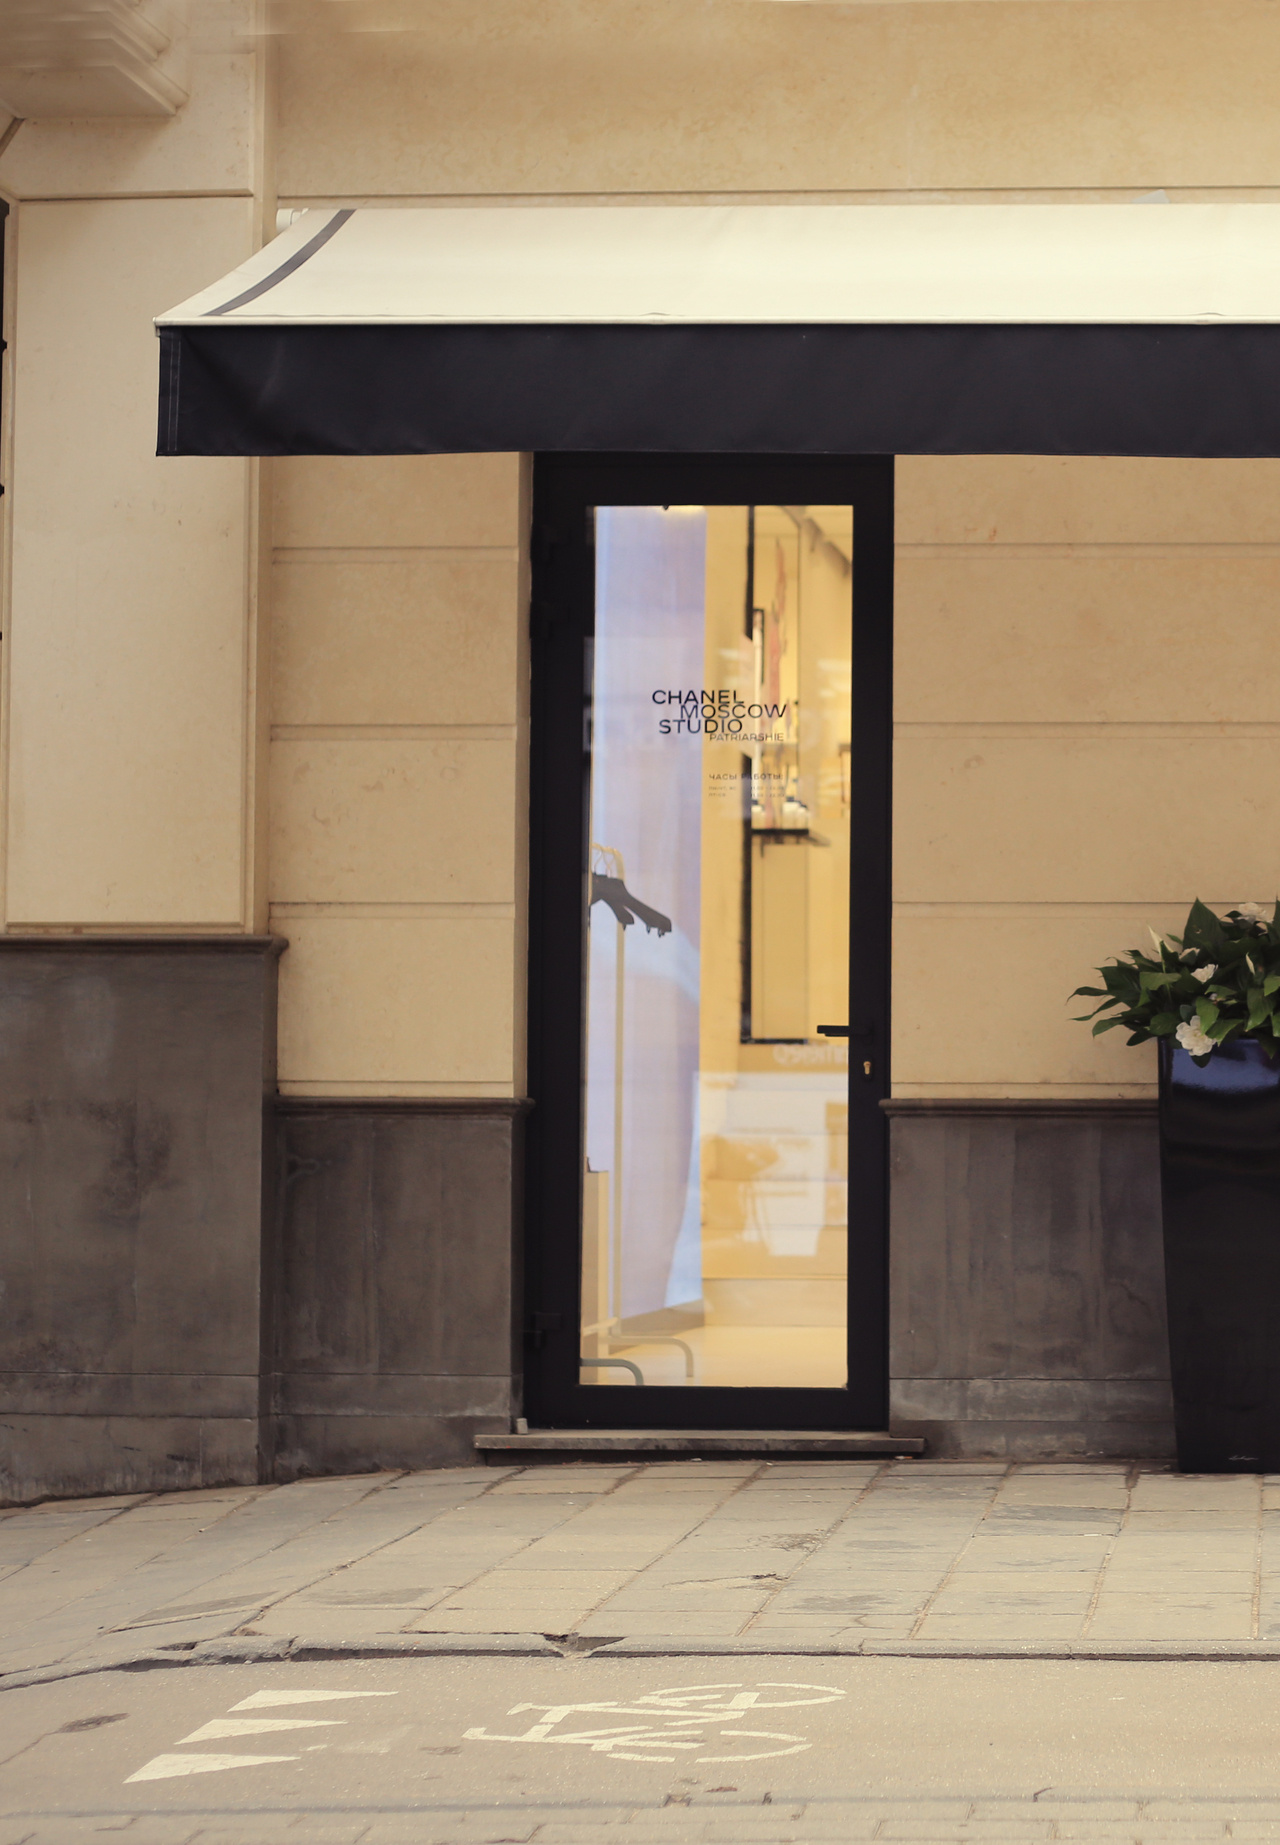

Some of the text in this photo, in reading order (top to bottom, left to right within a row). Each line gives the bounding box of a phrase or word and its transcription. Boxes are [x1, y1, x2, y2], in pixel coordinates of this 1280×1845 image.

[652, 690, 744, 704] CHANEL
[680, 704, 787, 719] MOSCOW
[659, 719, 743, 734] STUDIO
[709, 732, 784, 742] PATRIARSHIE
